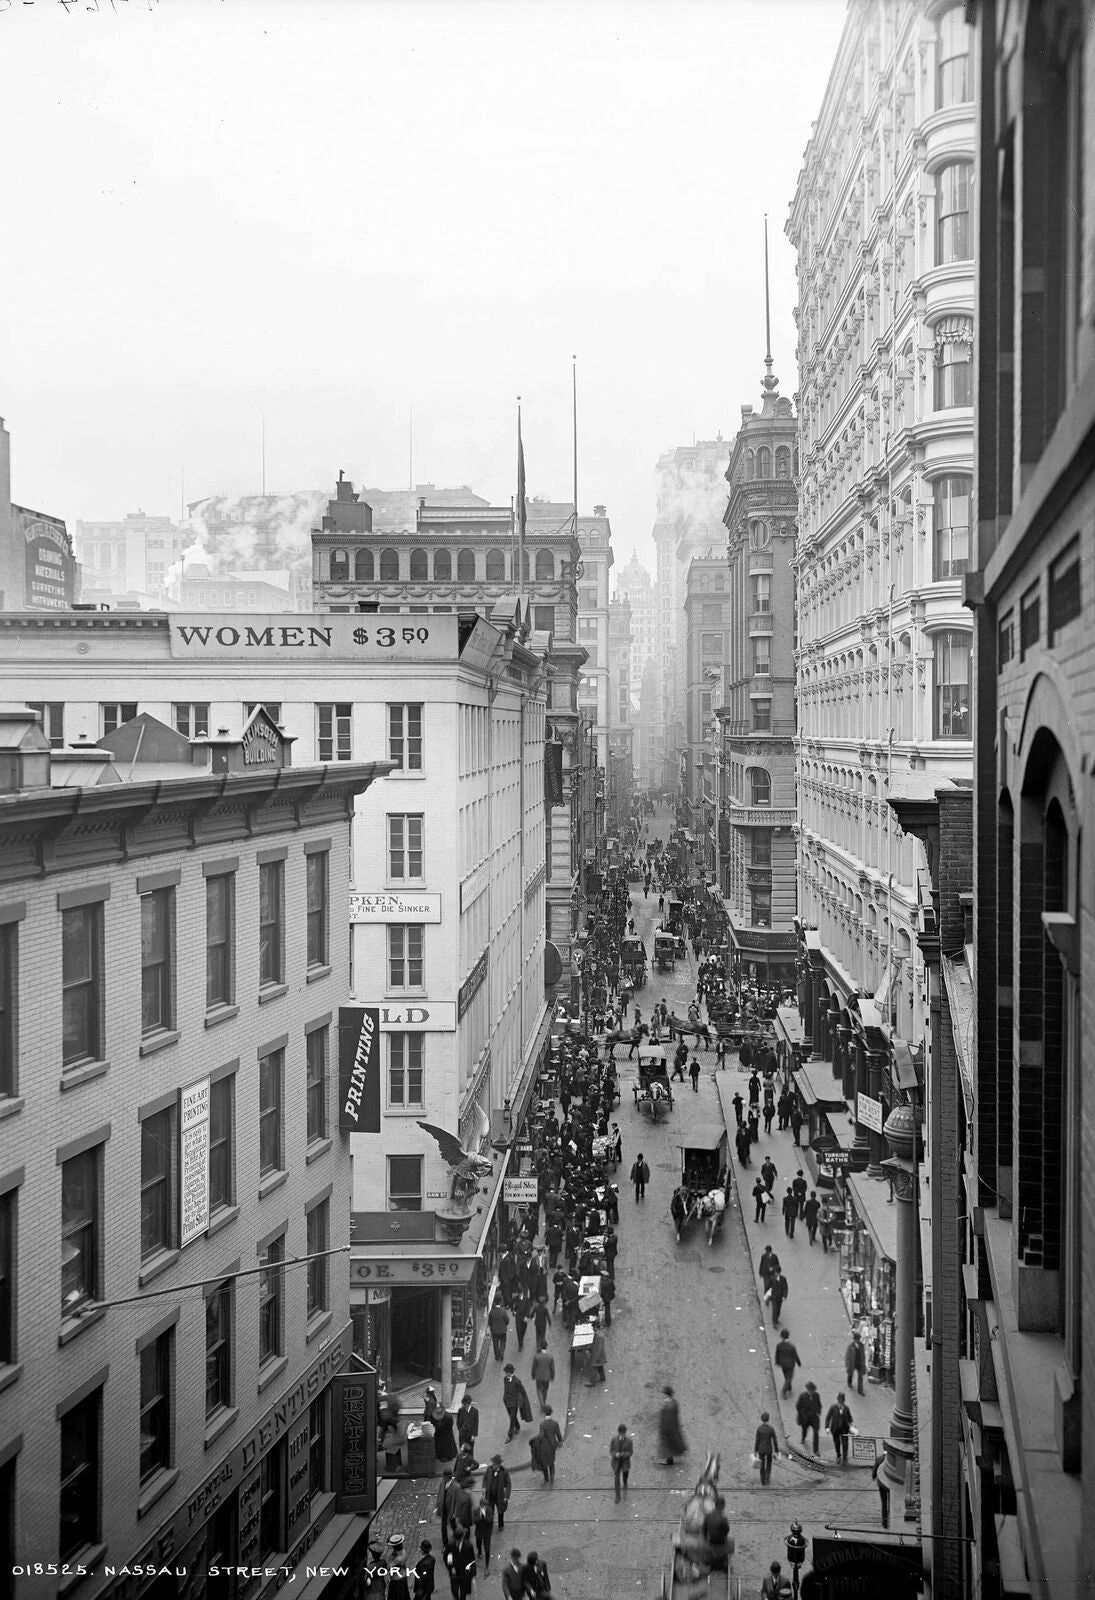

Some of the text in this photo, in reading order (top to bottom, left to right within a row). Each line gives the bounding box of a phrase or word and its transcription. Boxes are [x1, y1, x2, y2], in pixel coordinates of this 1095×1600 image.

[176, 626, 332, 647] WOMEN
[245, 749, 276, 764] BUILDING
[381, 1008, 430, 1024] LD
[344, 1012, 377, 1122] PRINTING
[184, 1086, 208, 1109] FINE ART
[184, 1100, 208, 1123] PRINTING
[344, 1386, 364, 1494] DENTISTS
[288, 1490, 310, 1528] PLATES
